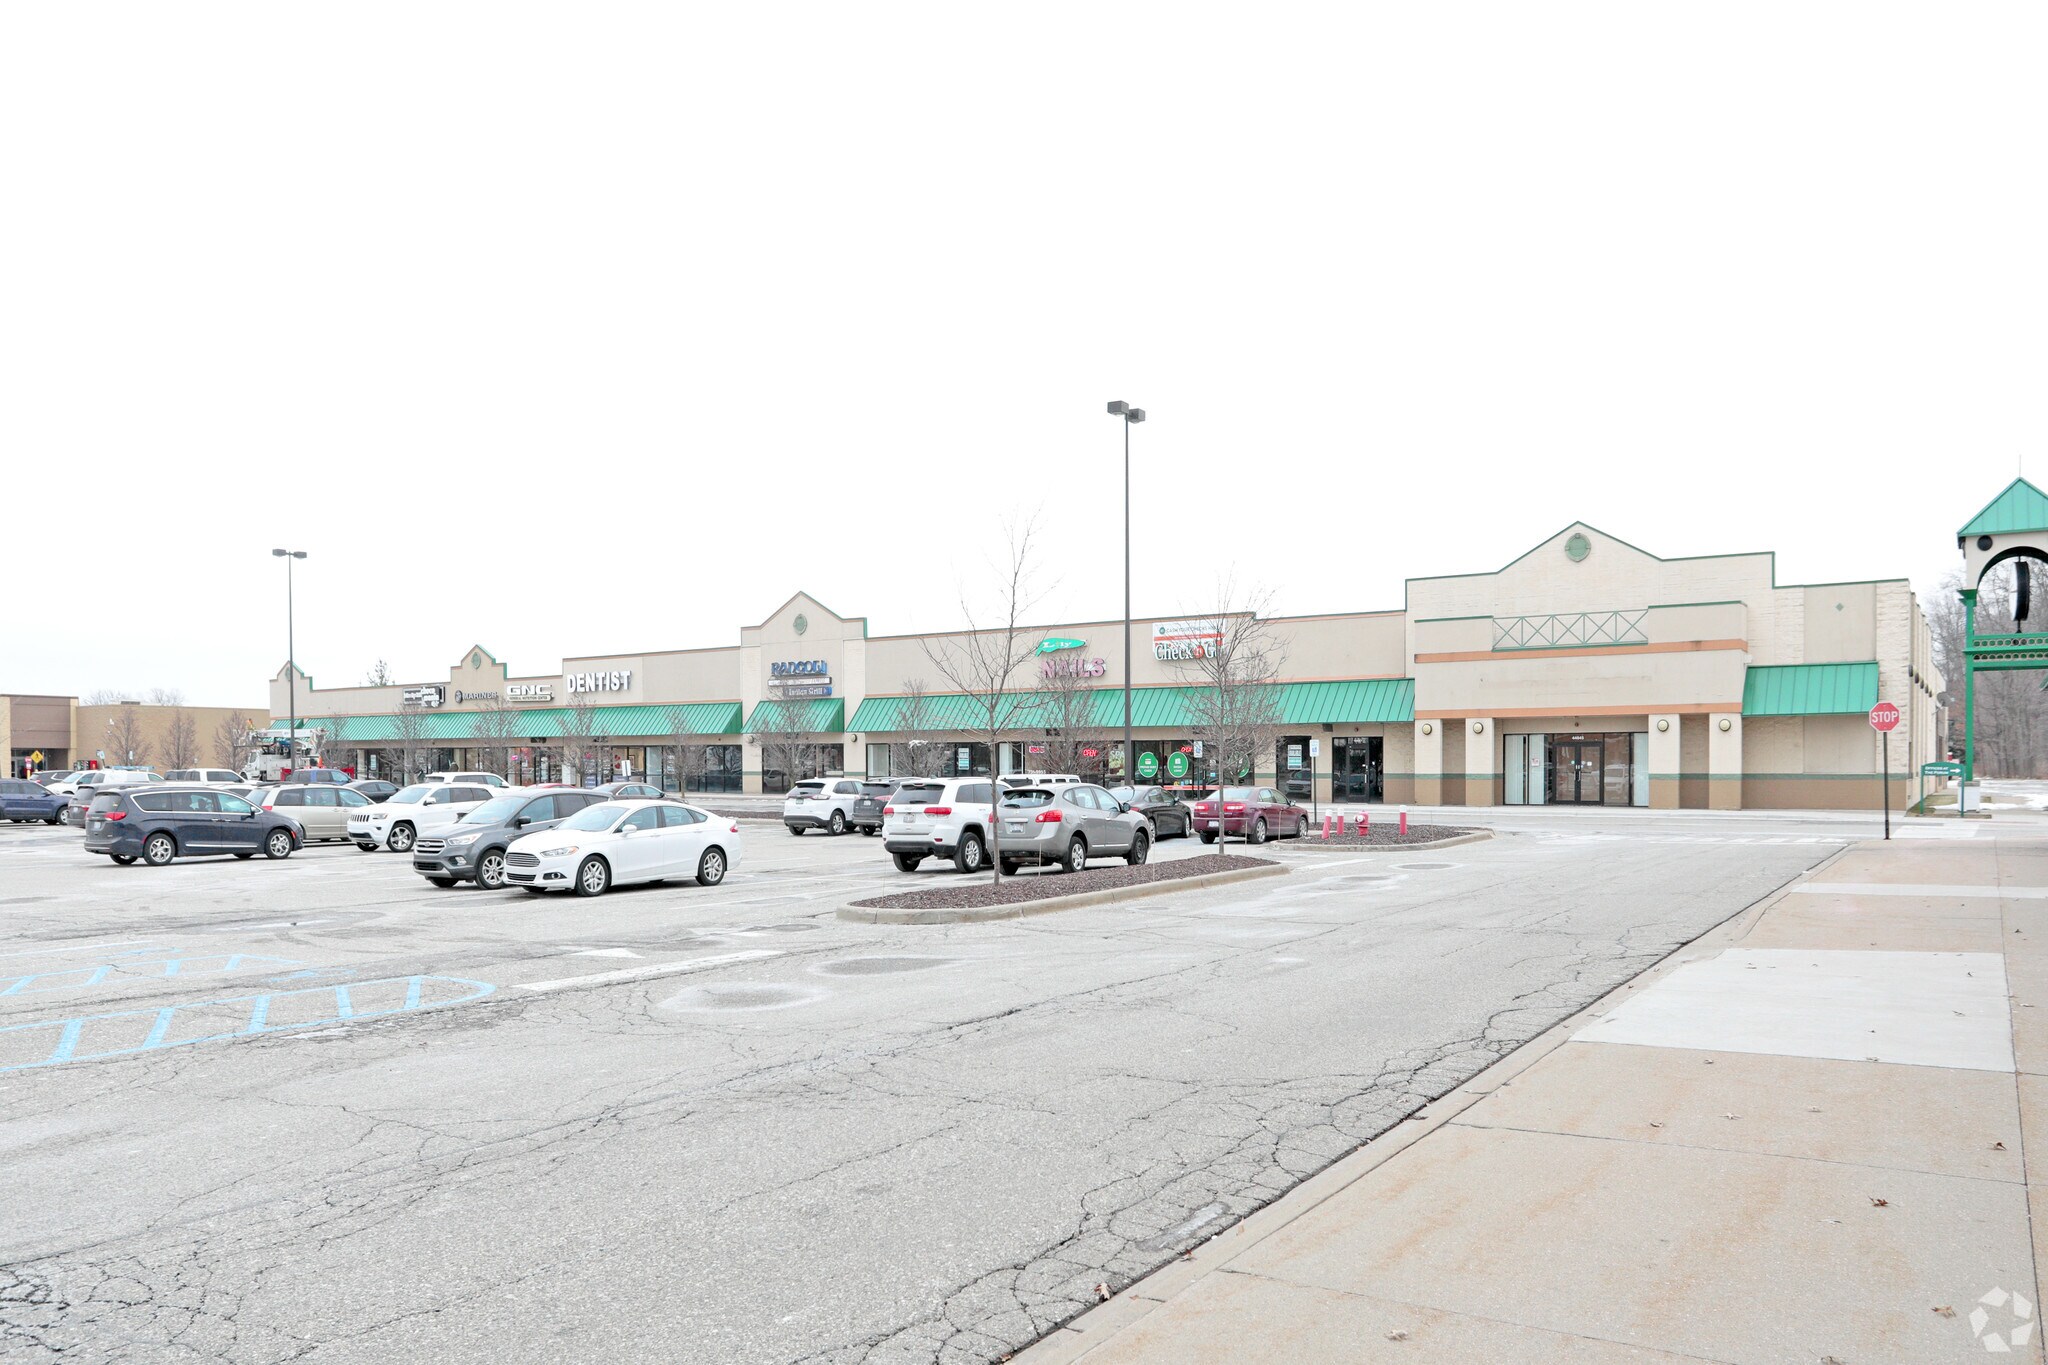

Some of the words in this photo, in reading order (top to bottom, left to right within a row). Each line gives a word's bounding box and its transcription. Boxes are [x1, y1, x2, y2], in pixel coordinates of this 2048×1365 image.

[1155, 641, 1194, 661] Check
[1041, 657, 1105, 678] NAILS
[506, 684, 551, 695] GNC
[567, 670, 632, 693] DENTIST
[1871, 711, 1898, 723] STOP
[1083, 747, 1098, 757] OPEN
